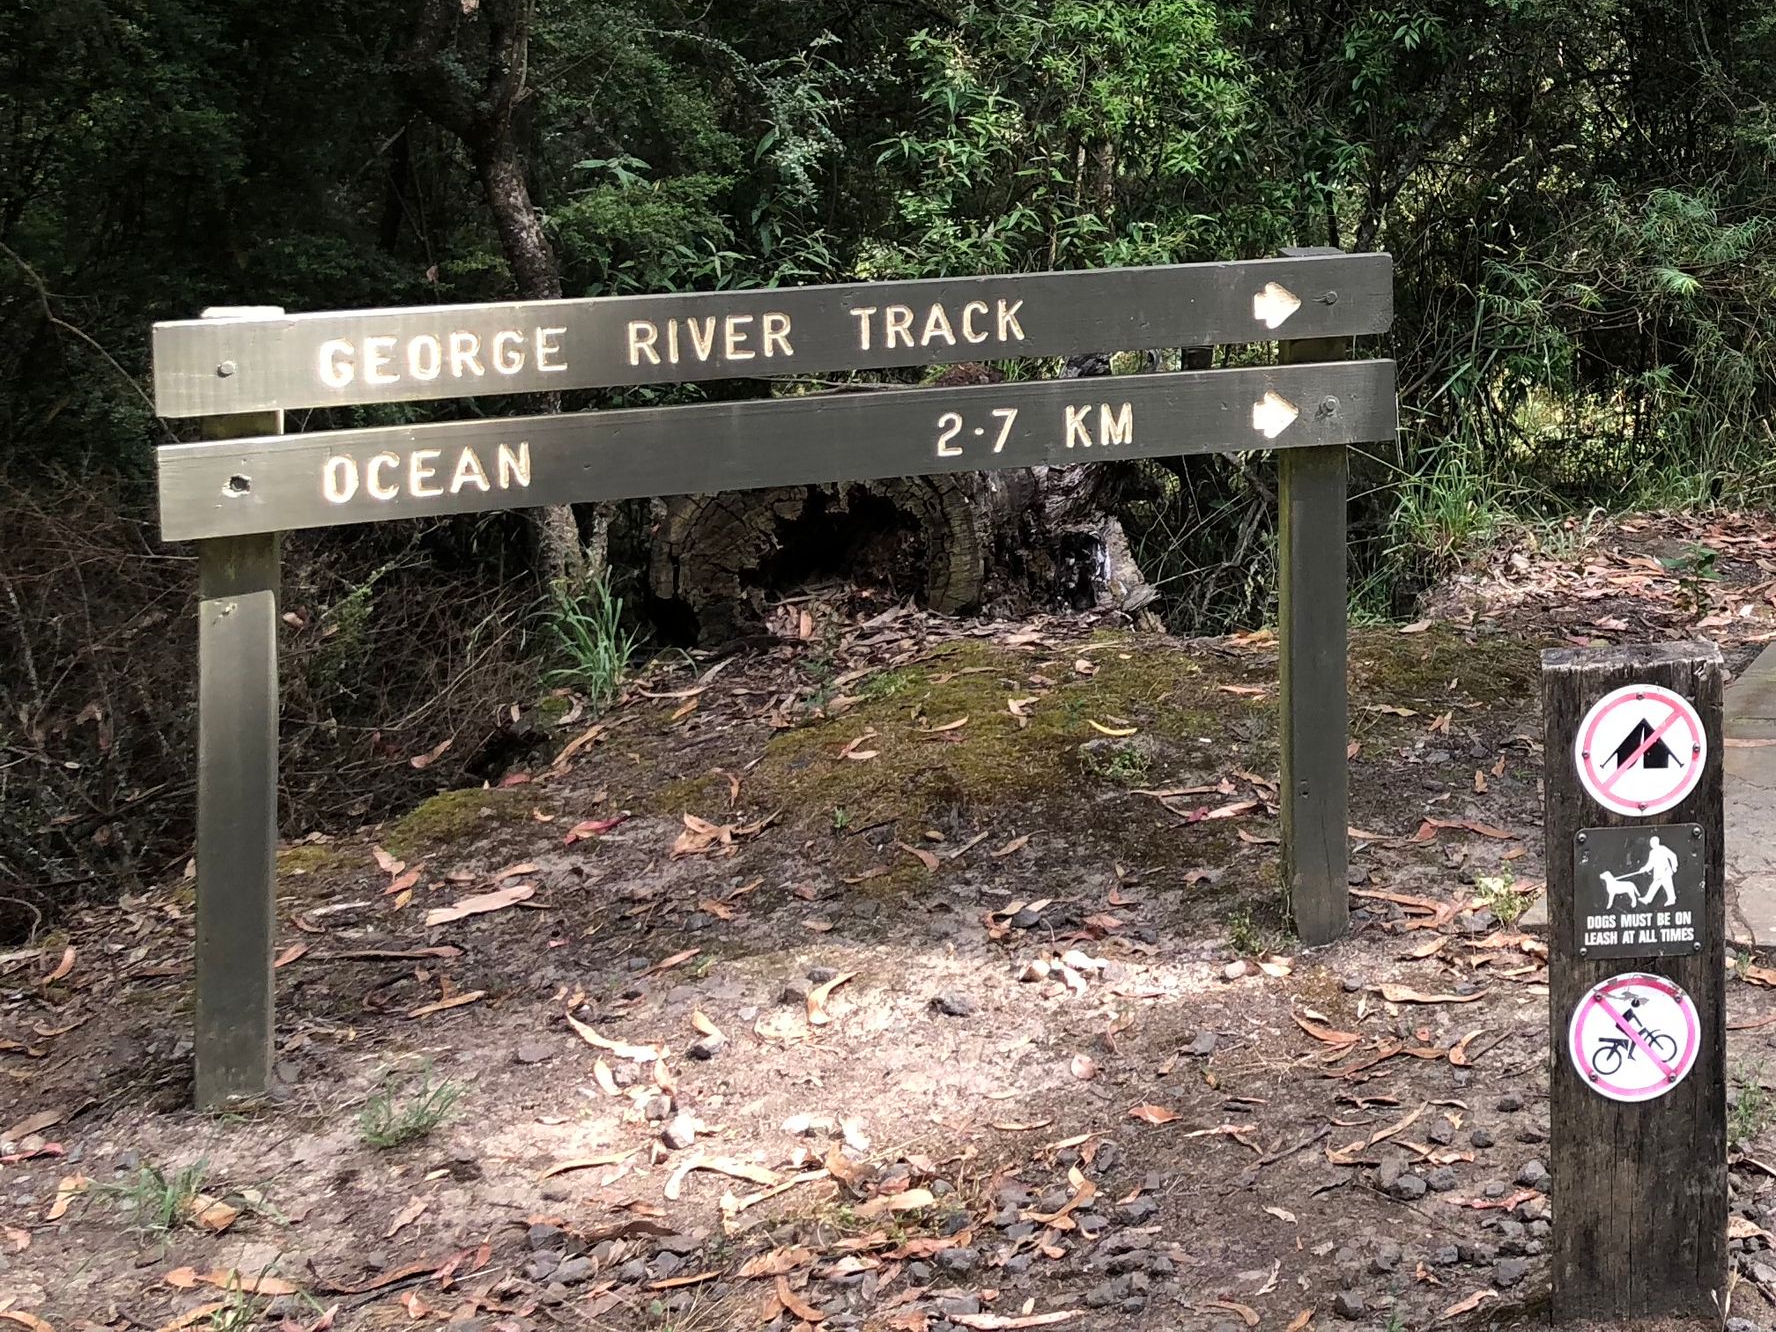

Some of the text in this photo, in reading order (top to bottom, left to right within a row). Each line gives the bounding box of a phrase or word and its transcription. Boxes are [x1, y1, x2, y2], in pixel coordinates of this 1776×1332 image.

[319, 299, 1026, 387] GEORGE RIVER TRACK
[323, 441, 531, 503] OCEAN
[1065, 401, 1133, 448] KM
[1584, 927, 1694, 946] LEASH AT ALL TIMES
[1587, 911, 1692, 930] DOGS MUST BE ON
